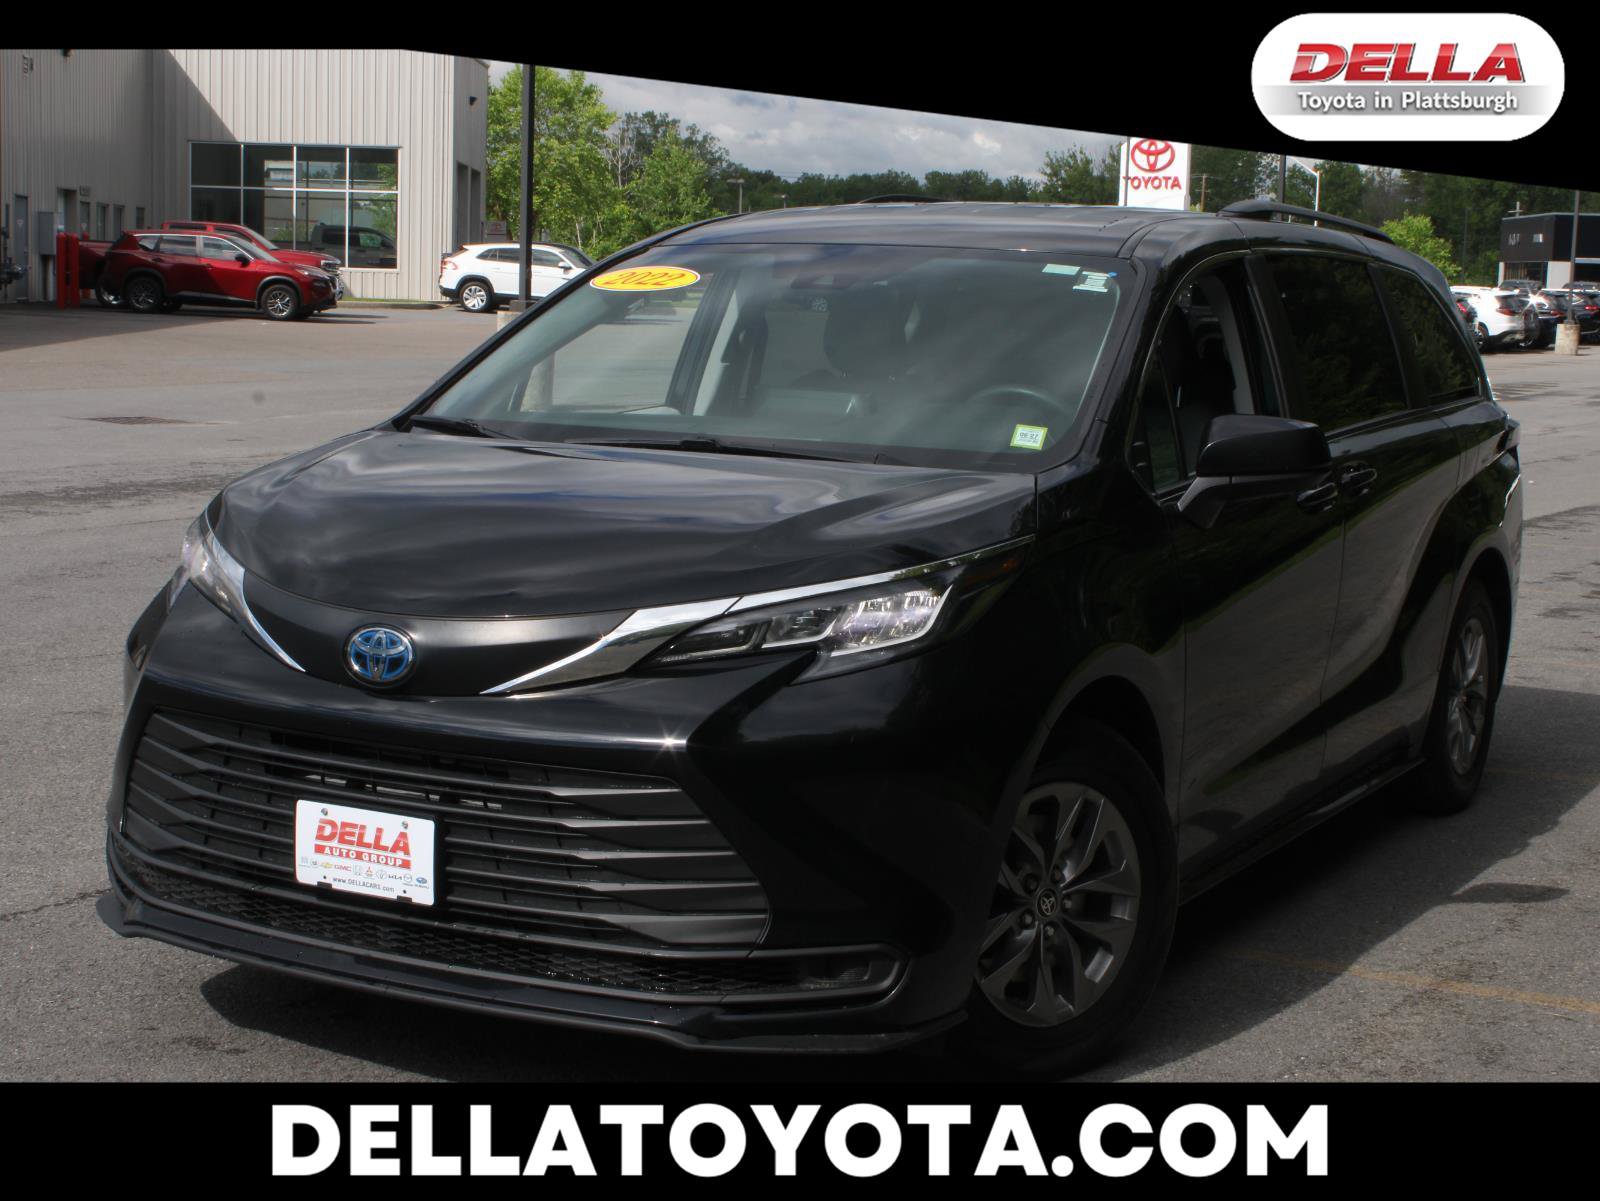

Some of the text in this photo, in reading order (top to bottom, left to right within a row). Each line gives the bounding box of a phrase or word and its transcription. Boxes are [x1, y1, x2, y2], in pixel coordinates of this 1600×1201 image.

[1122, 176, 1182, 190] TOYOTA
[600, 271, 686, 286] 2022
[315, 818, 411, 857] DELLA
[323, 846, 403, 867] AUTO GROUP
[334, 864, 352, 872] GMC
